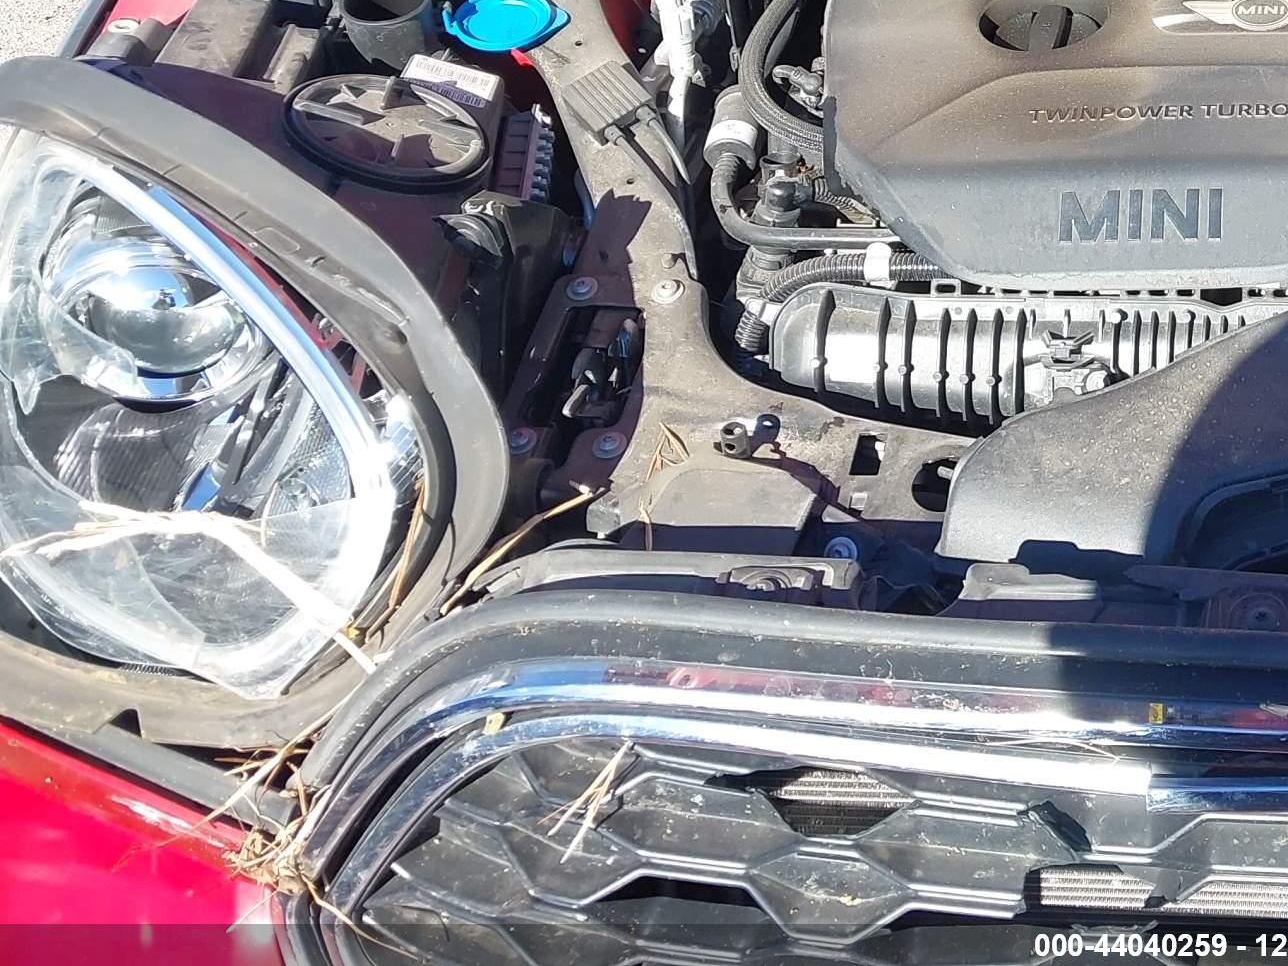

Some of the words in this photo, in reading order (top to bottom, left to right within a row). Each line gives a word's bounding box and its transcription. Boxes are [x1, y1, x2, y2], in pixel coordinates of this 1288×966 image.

[1237, 4, 1285, 16] MINI
[1029, 104, 1194, 123] TWINPOWER
[1058, 188, 1223, 244] MINI
